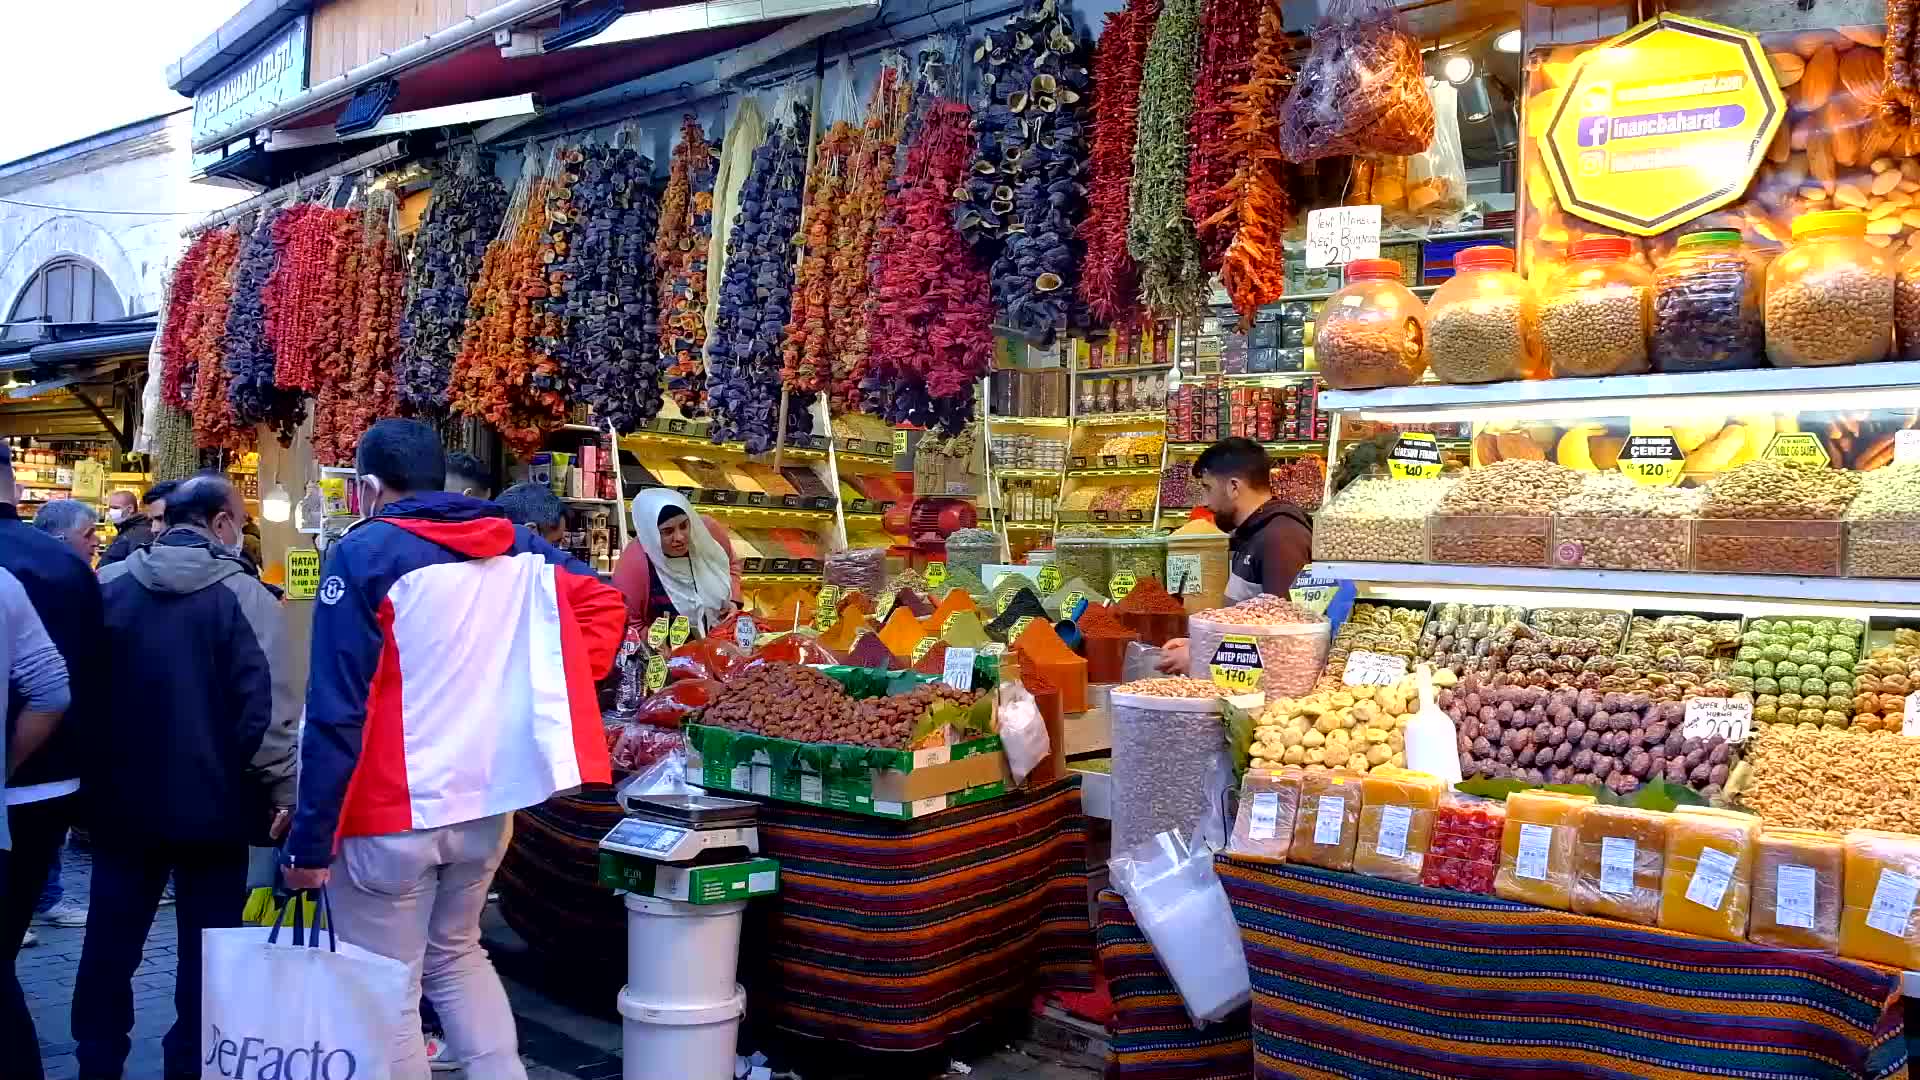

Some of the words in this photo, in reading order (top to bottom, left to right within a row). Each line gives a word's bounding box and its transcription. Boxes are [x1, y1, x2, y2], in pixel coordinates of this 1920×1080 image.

[1613, 108, 1721, 138] inancbaharat
[1630, 446, 1673, 458] ÇEREZ
[1404, 464, 1423, 476] 140
[1638, 463, 1664, 476] 120
[291, 557, 317, 566] HATAY
[1303, 590, 1322, 602] 190
[1216, 651, 1236, 662] ANTEP
[1236, 651, 1258, 664] FISTIĞI
[1225, 668, 1246, 683] 170
[1704, 718, 1743, 742] 200
